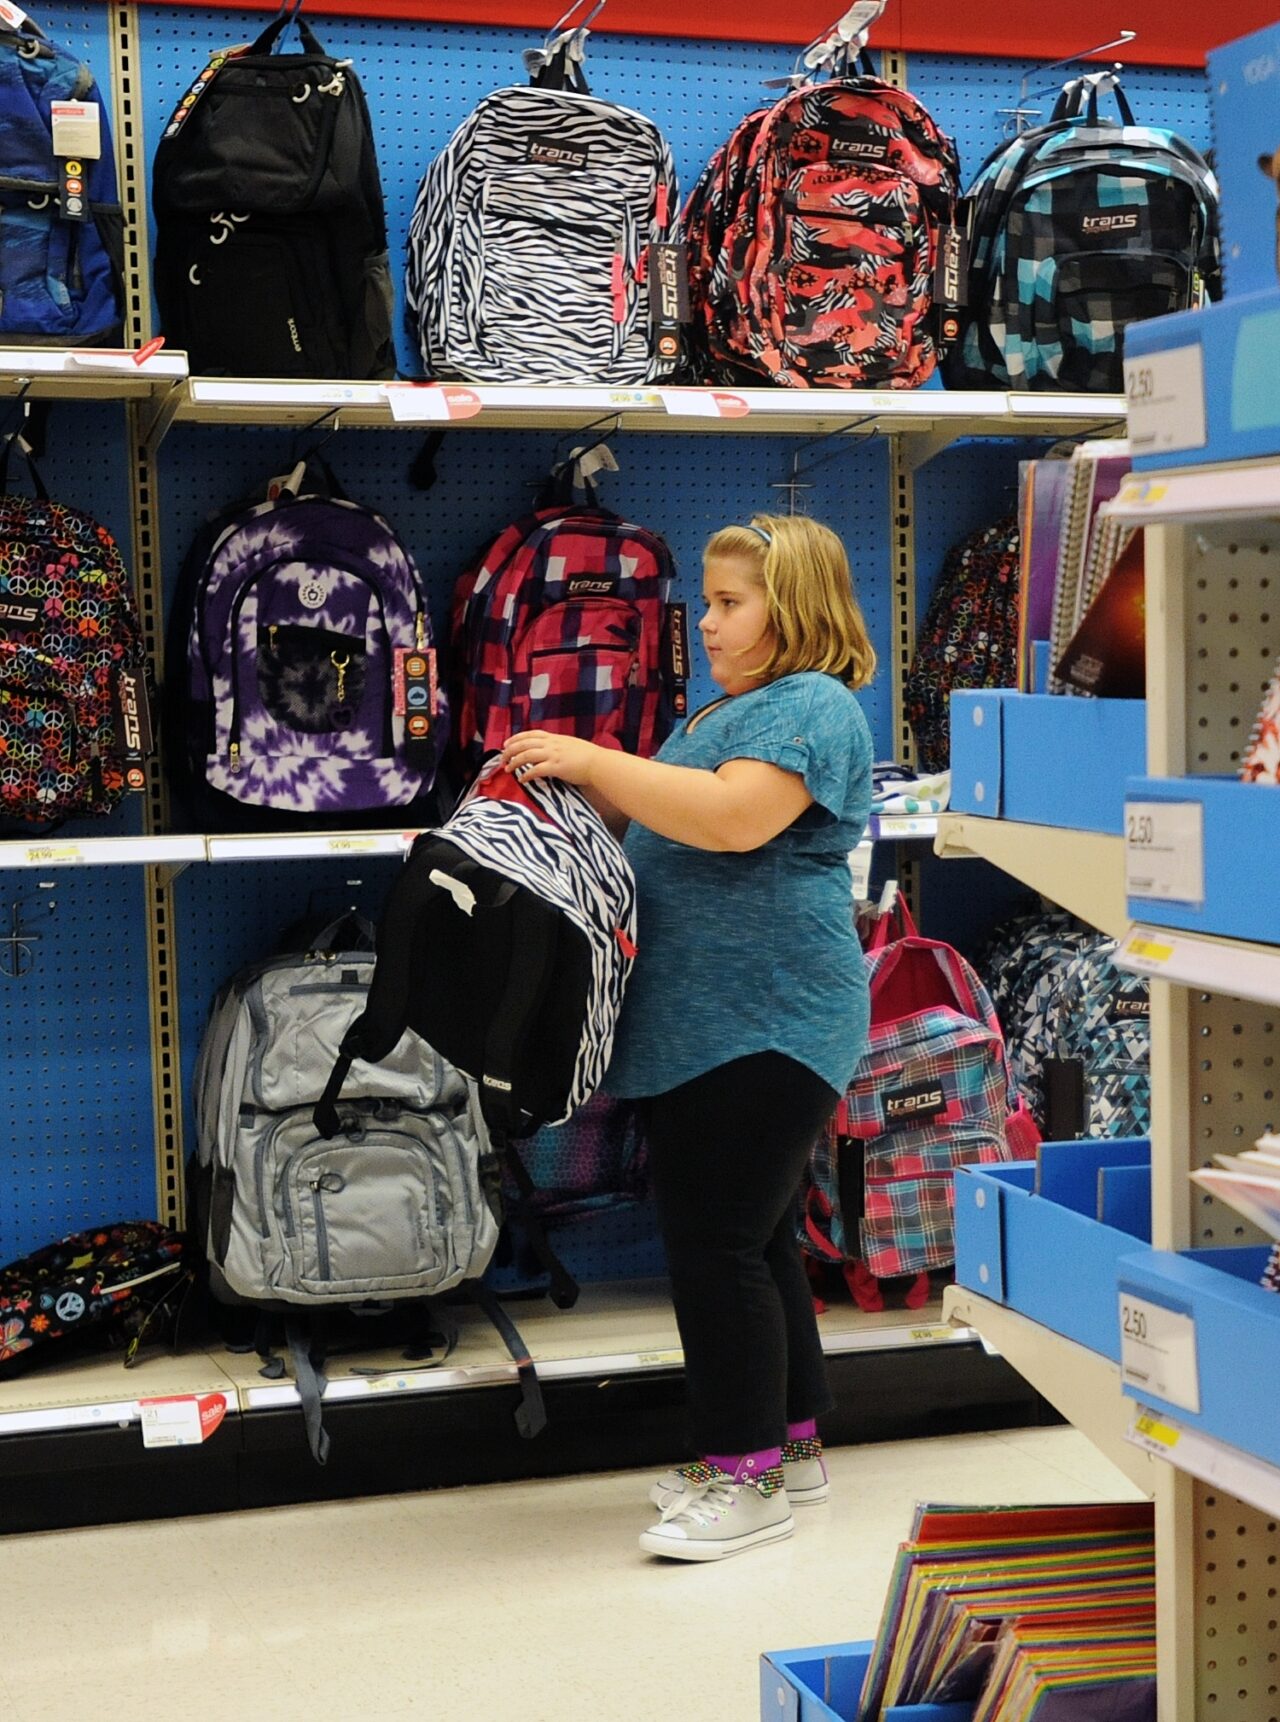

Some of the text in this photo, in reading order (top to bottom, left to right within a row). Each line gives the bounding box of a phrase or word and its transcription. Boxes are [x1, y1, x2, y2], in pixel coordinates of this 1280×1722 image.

[530, 142, 586, 166] trans
[831, 138, 887, 158] trans
[1082, 214, 1138, 229] trans
[944, 231, 962, 302] trans
[662, 249, 678, 320] trans
[569, 580, 613, 592] trans
[0, 604, 38, 622] ans
[672, 609, 684, 676] trans
[124, 676, 141, 750] trans
[1127, 815, 1153, 843] 2.50
[1115, 999, 1151, 1014] tran
[887, 1090, 942, 1111] trans
[1123, 1306, 1147, 1339] 2.50
[201, 1403, 224, 1421] sale
